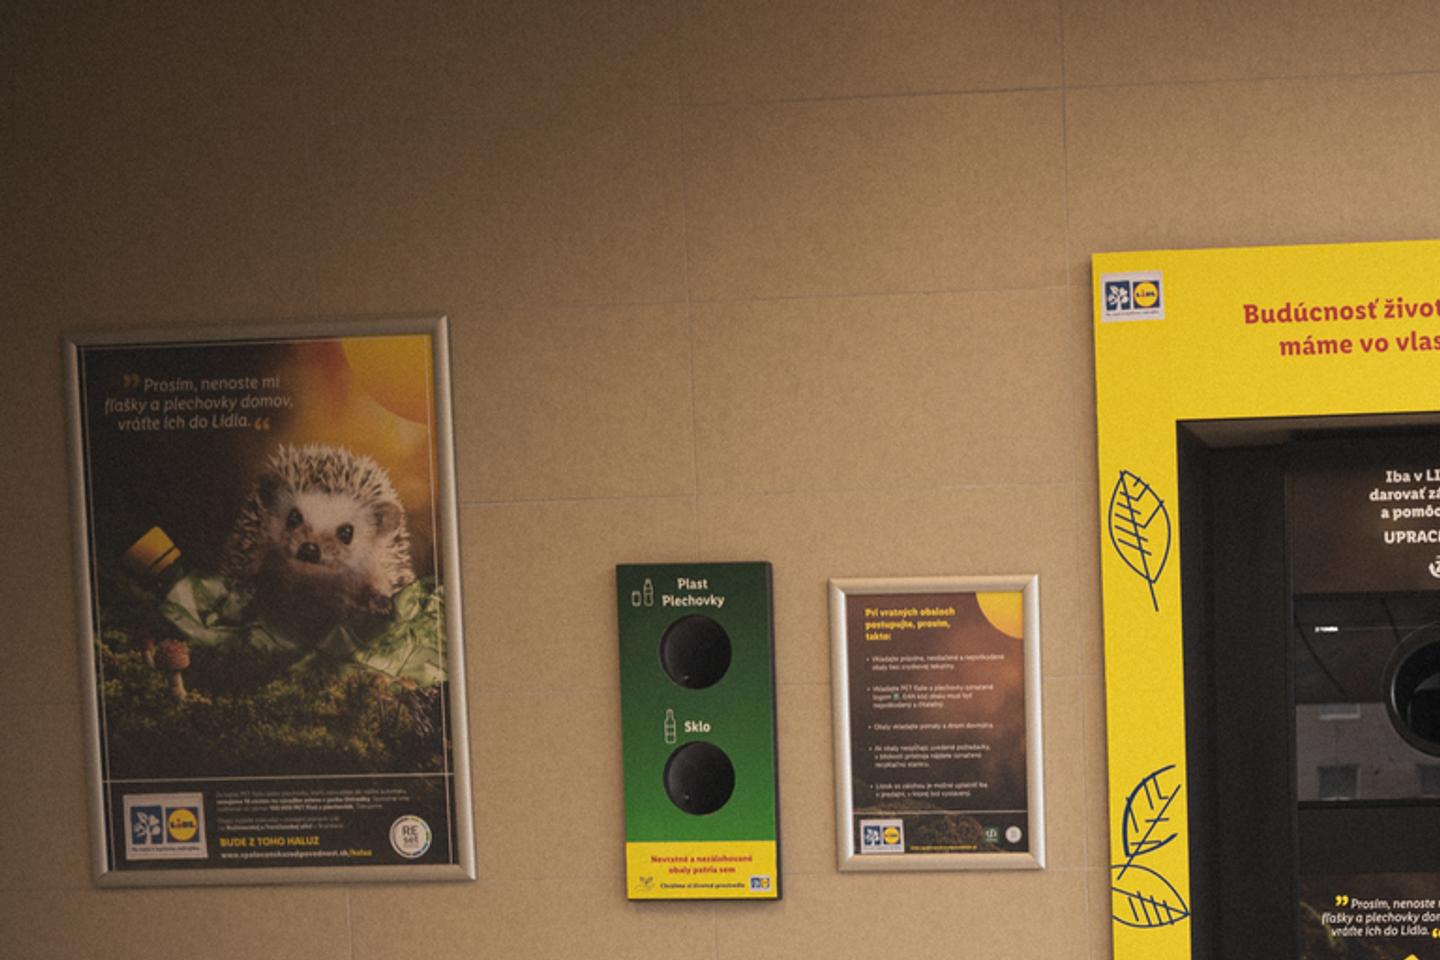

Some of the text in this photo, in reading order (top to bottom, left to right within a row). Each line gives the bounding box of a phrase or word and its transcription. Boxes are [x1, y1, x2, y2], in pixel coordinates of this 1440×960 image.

[1243, 298, 1380, 324] Budúcnosť
[1280, 335, 1353, 356] máme
[1360, 337, 1389, 353] vo
[201, 377, 257, 391] nenoste
[262, 375, 280, 389] mi
[150, 402, 159, 412] a
[163, 396, 237, 413] plechovky
[240, 394, 294, 409] domov,
[163, 416, 185, 430] ich
[188, 414, 208, 429] do
[1385, 470, 1410, 483] Iba
[1414, 473, 1423, 482] v
[1369, 487, 1426, 501] darovať
[1381, 509, 1390, 519] a
[677, 577, 708, 590] Plast
[662, 594, 725, 608] Plechovky
[684, 720, 711, 733] Sklo
[1393, 899, 1436, 909] nenoste
[1355, 914, 1363, 923] a
[1365, 911, 1420, 924] plechovky
[1365, 925, 1382, 936] ich
[1384, 925, 1398, 936] do
